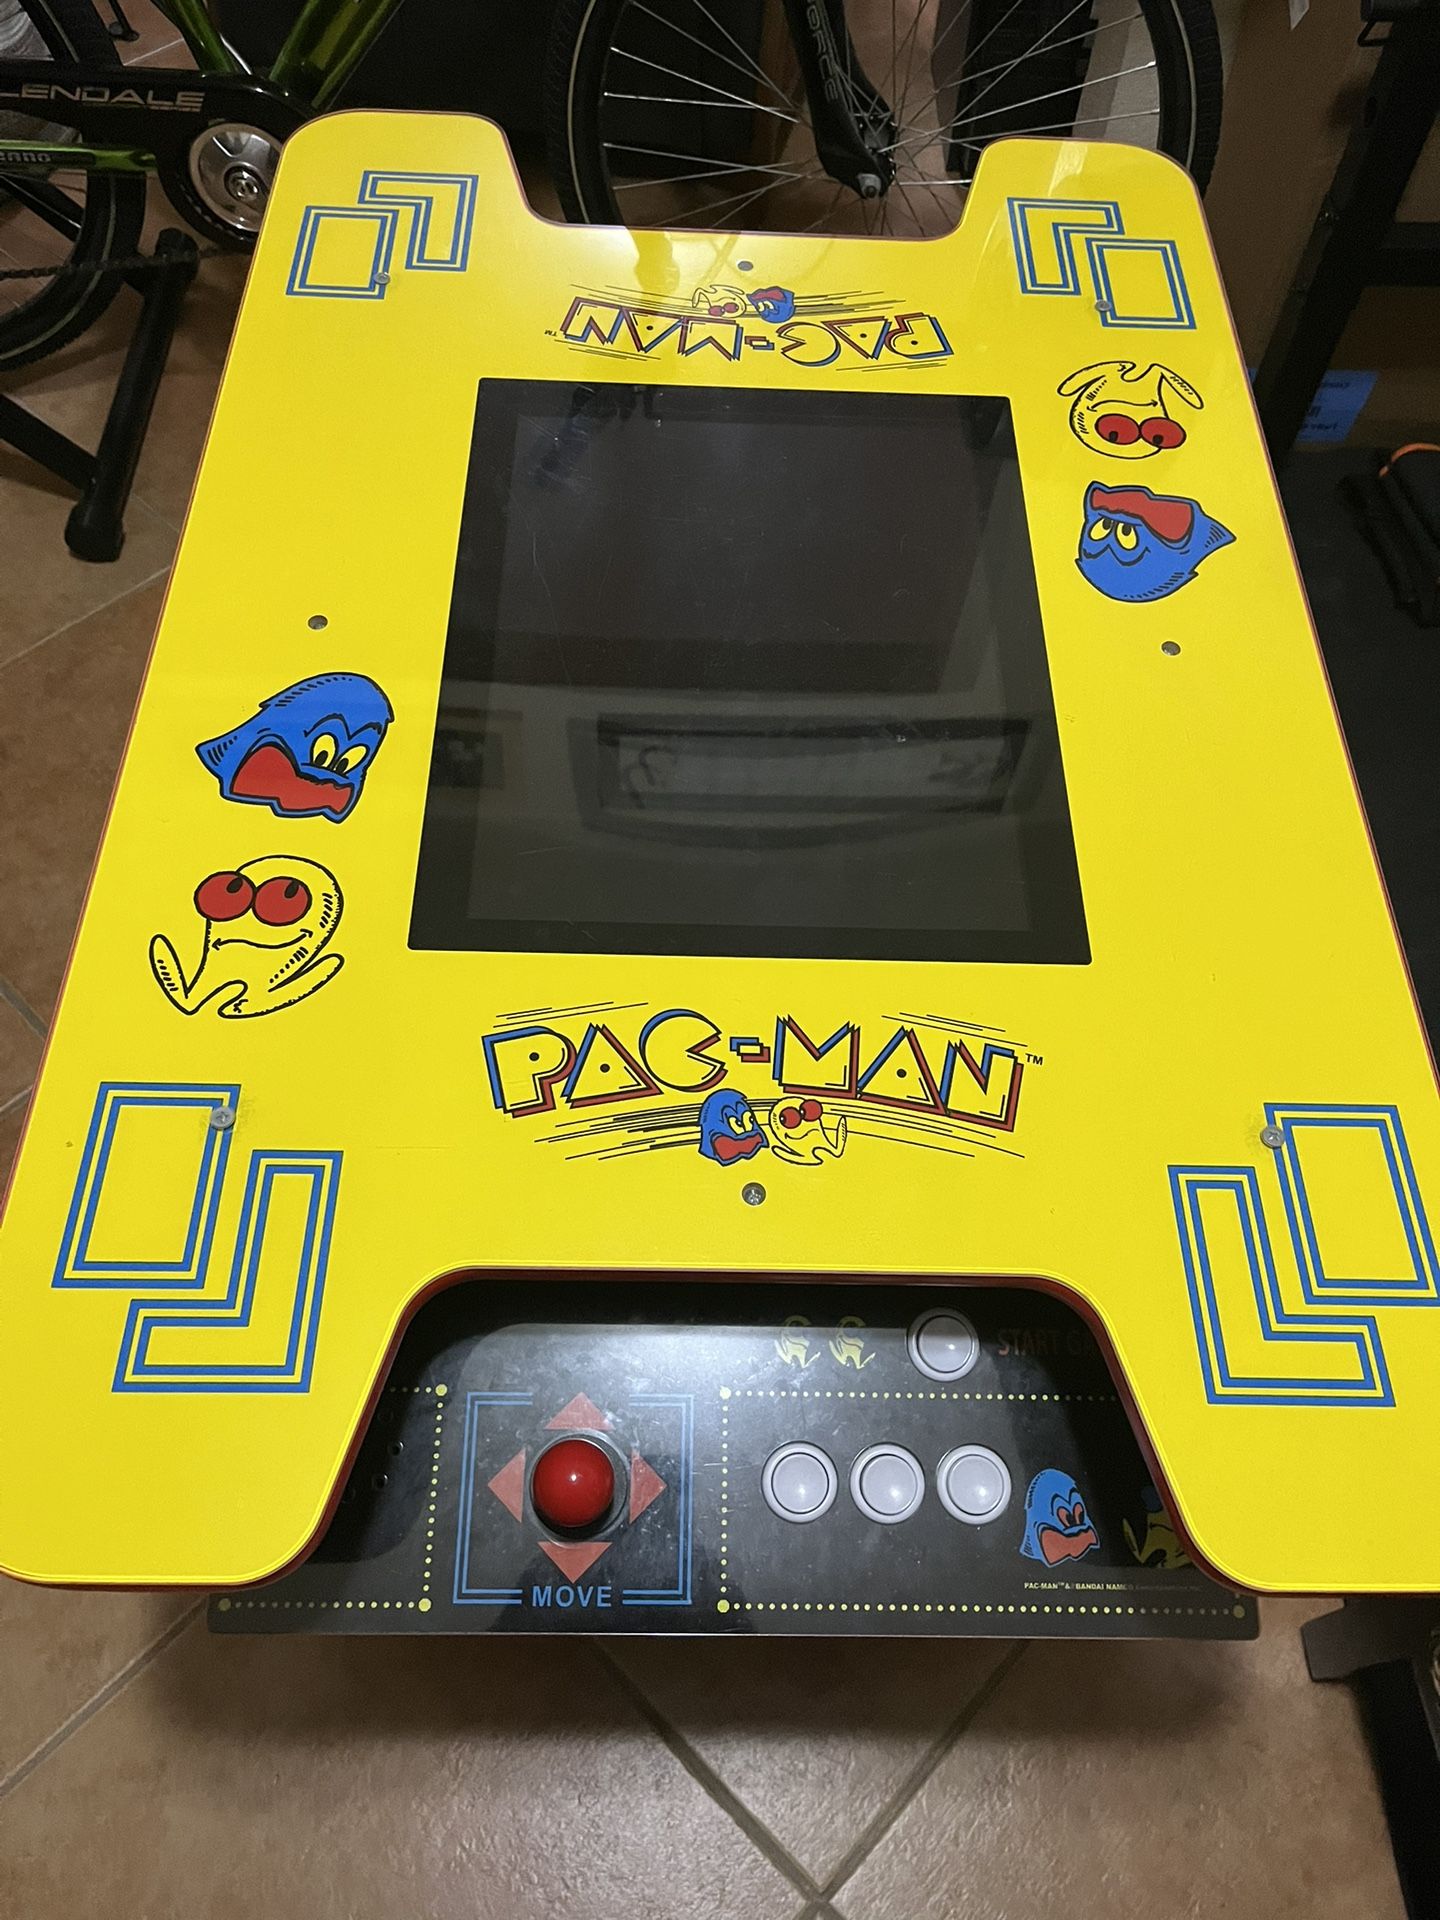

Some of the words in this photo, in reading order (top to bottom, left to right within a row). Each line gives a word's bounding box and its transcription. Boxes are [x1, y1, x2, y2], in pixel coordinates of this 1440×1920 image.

[806, 0, 838, 102] ORCE
[532, 1585, 612, 1608] MOVE
[1075, 1582, 1104, 1590] BANDAI
